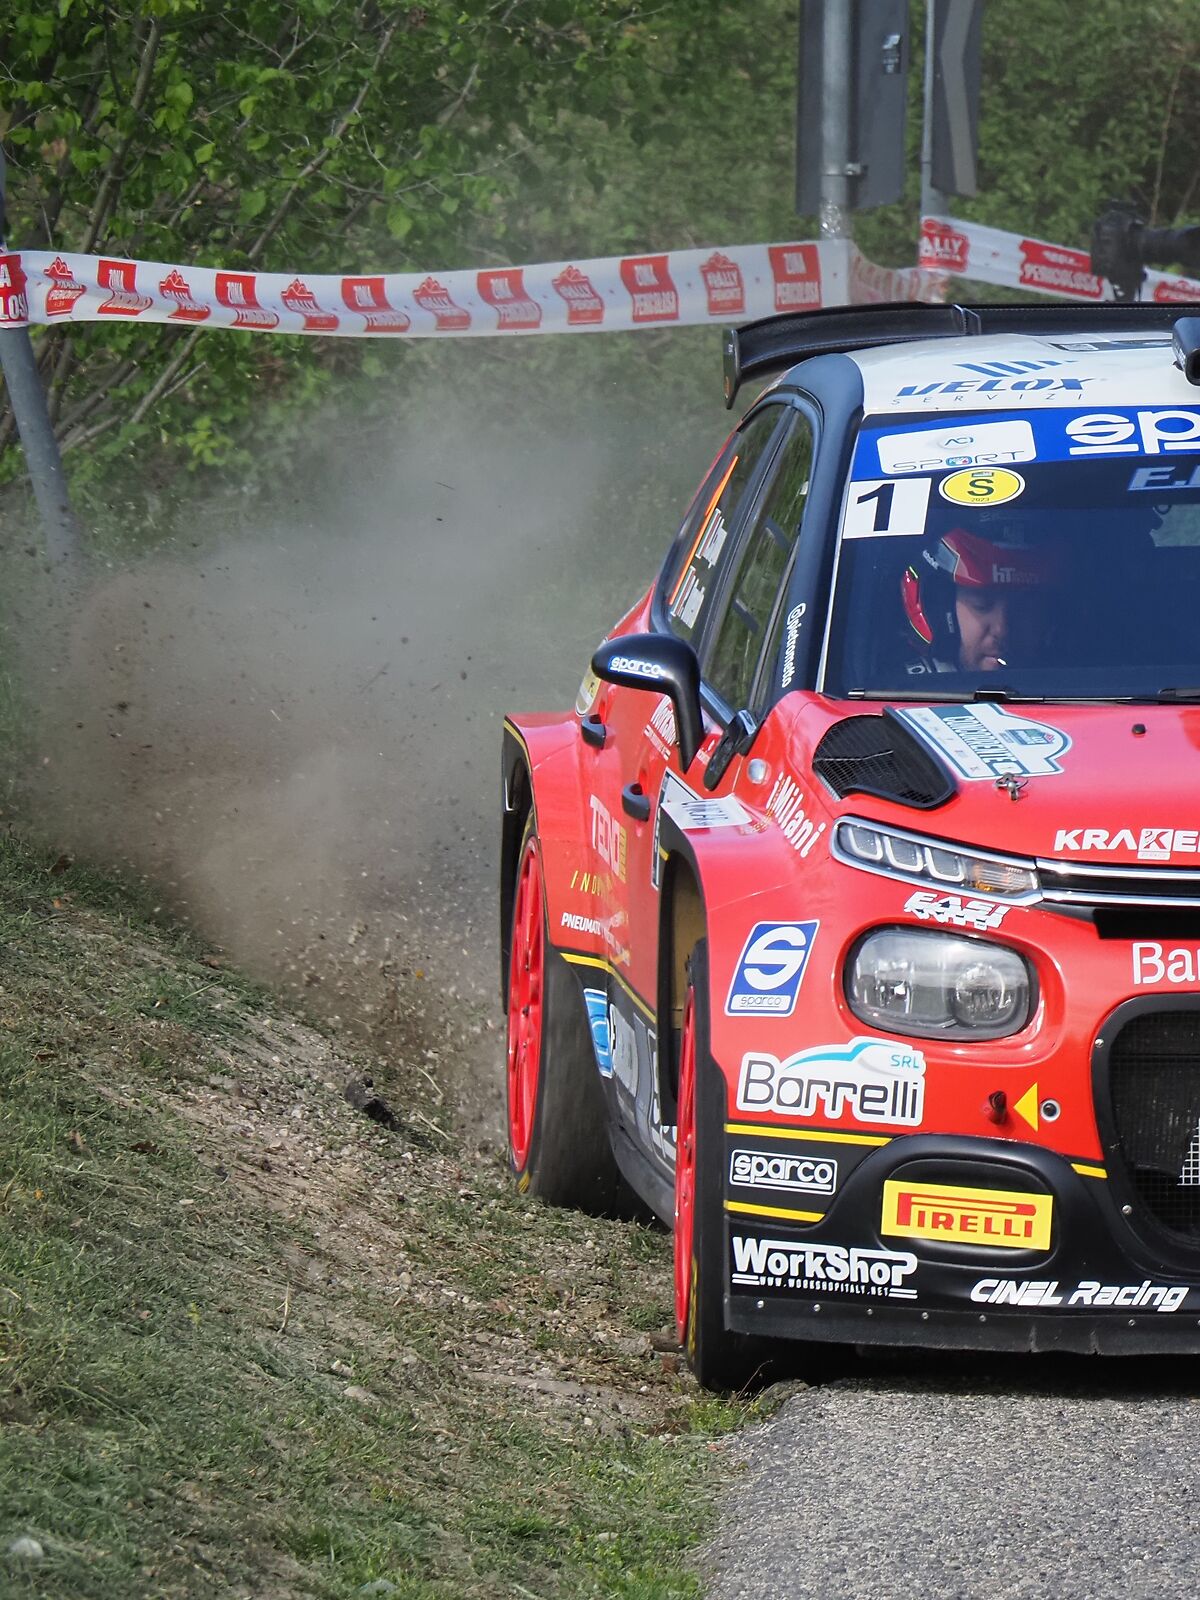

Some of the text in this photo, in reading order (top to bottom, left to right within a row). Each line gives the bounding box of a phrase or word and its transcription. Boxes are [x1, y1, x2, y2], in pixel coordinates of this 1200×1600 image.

[897, 378, 1095, 397] VELOX
[967, 478, 995, 497] S
[857, 483, 887, 533] 1
[610, 656, 663, 679] sparco
[739, 995, 783, 1008] sparco
[890, 1054, 920, 1069] SRL
[732, 1153, 834, 1192] sparco
[896, 1192, 1037, 1238] PIRELLI
[970, 1278, 1190, 1312] CINEL Racing
